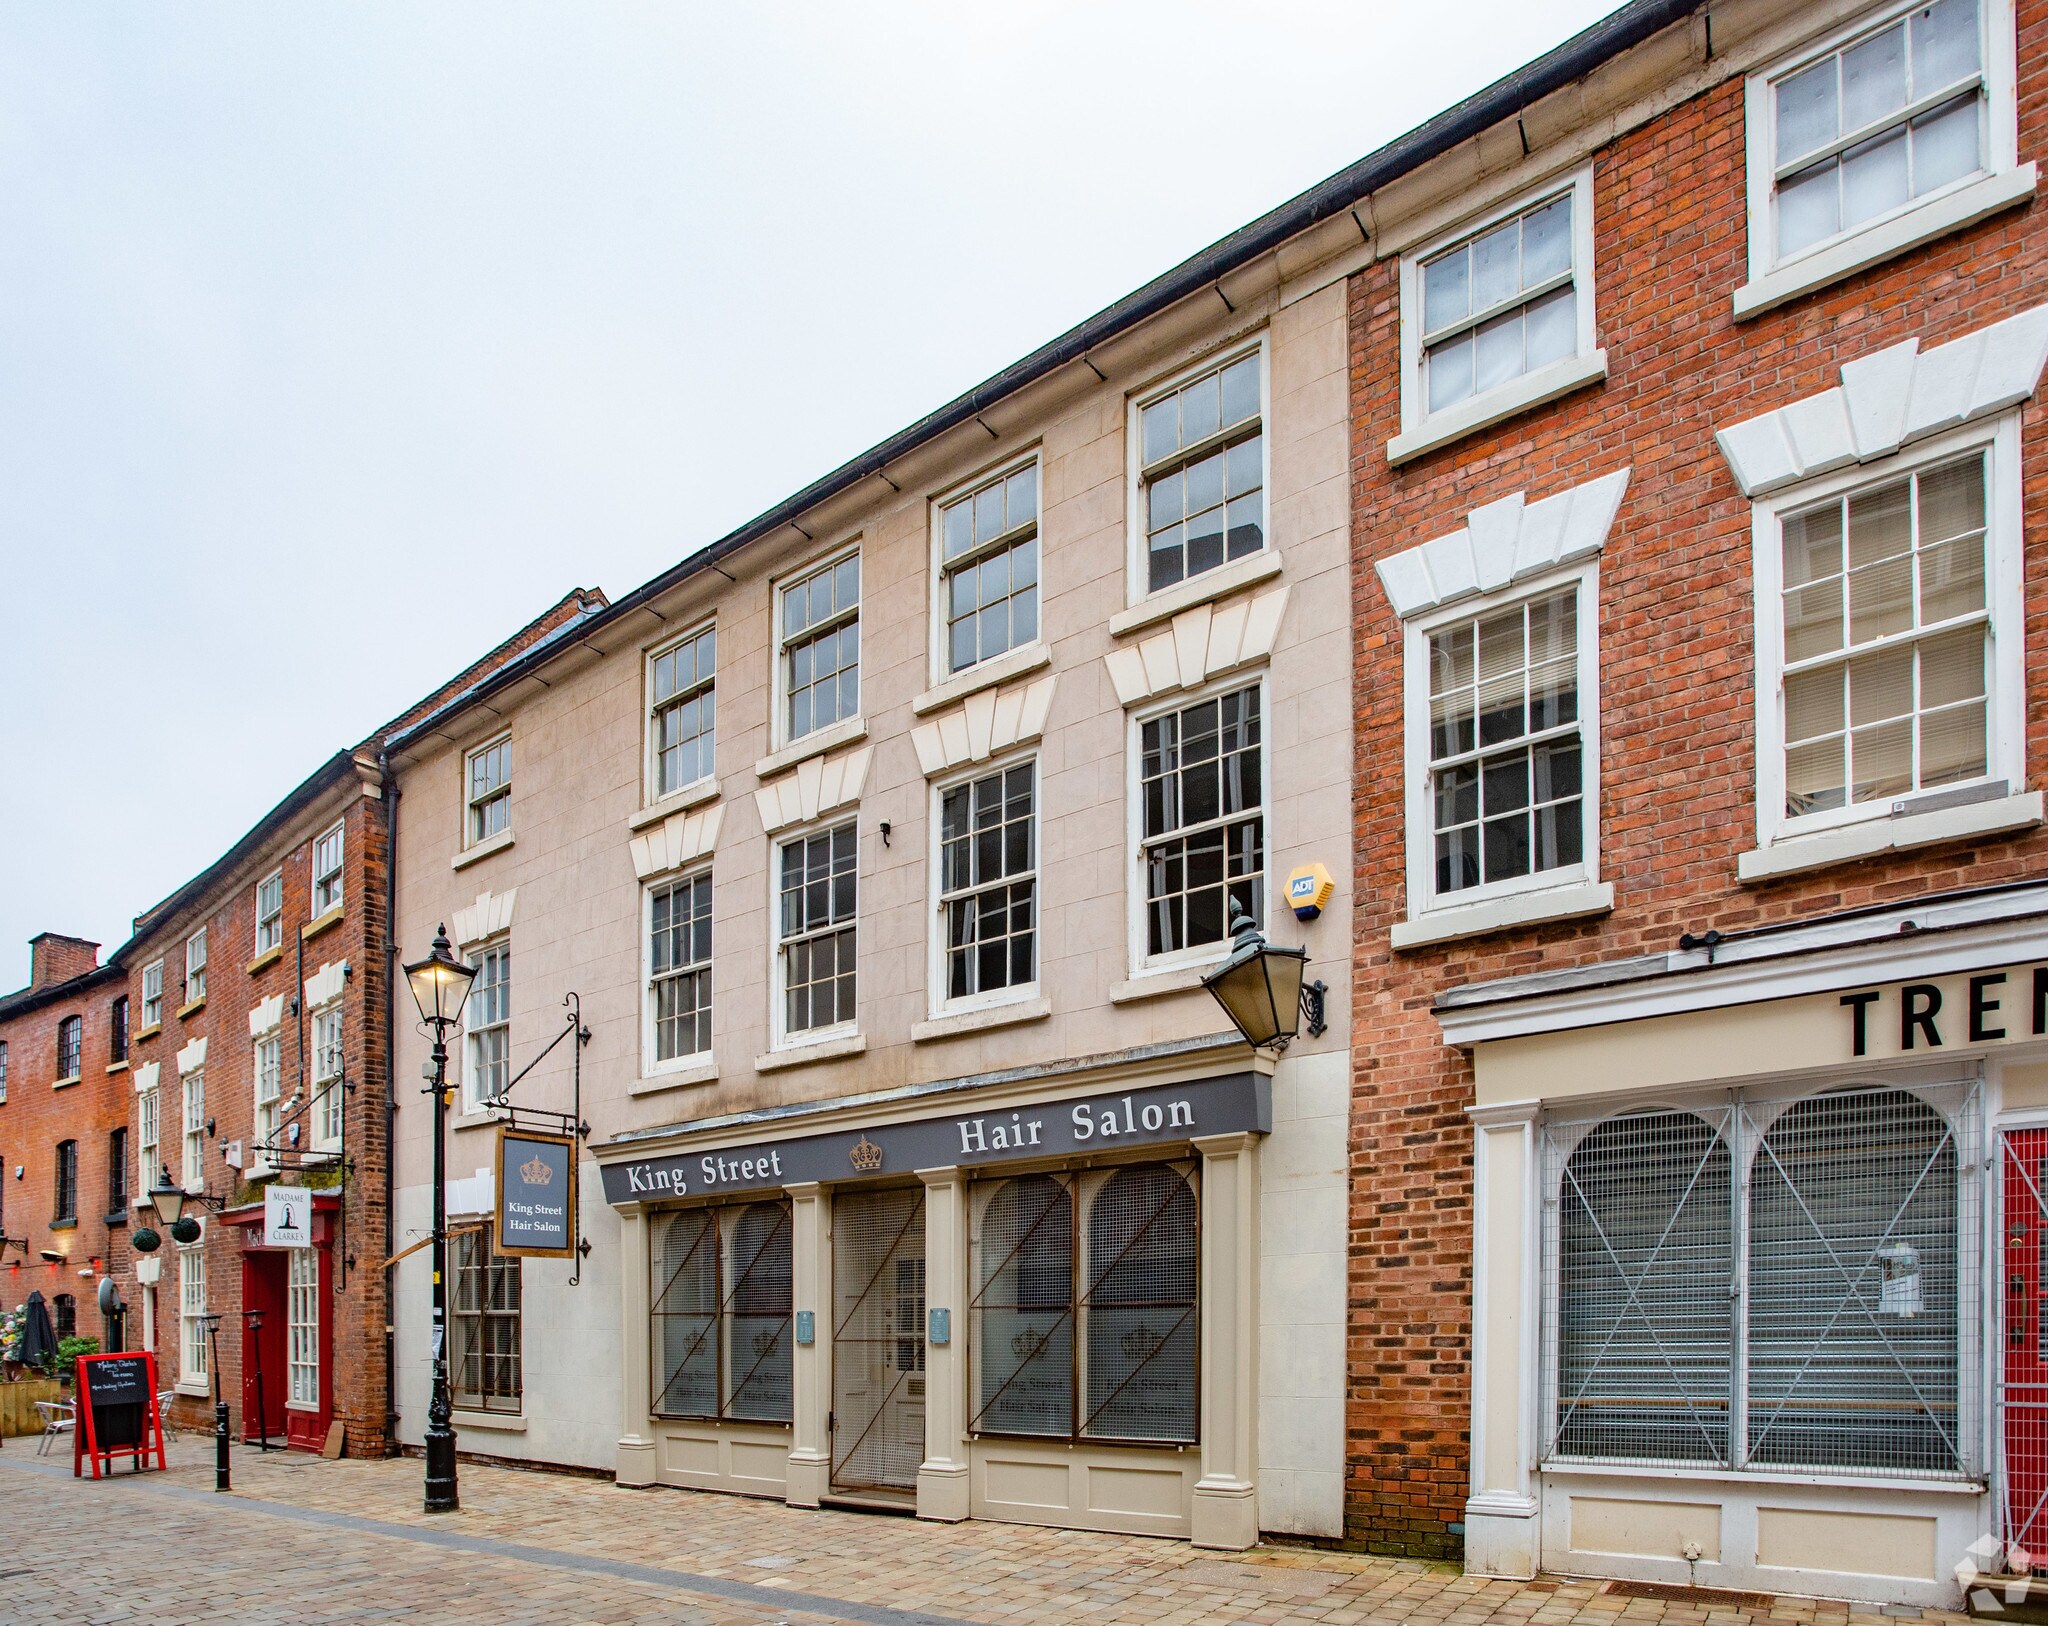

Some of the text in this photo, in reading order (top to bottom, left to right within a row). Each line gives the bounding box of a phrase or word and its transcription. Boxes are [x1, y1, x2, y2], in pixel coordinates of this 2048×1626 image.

[1292, 879, 1314, 894] ADT
[626, 1096, 1195, 1196] King Street Hair Salon
[273, 1193, 304, 1203] MADAME
[508, 1202, 562, 1216] King Street
[510, 1219, 560, 1232] Hair Salon
[273, 1230, 304, 1241] CLARKE'S
